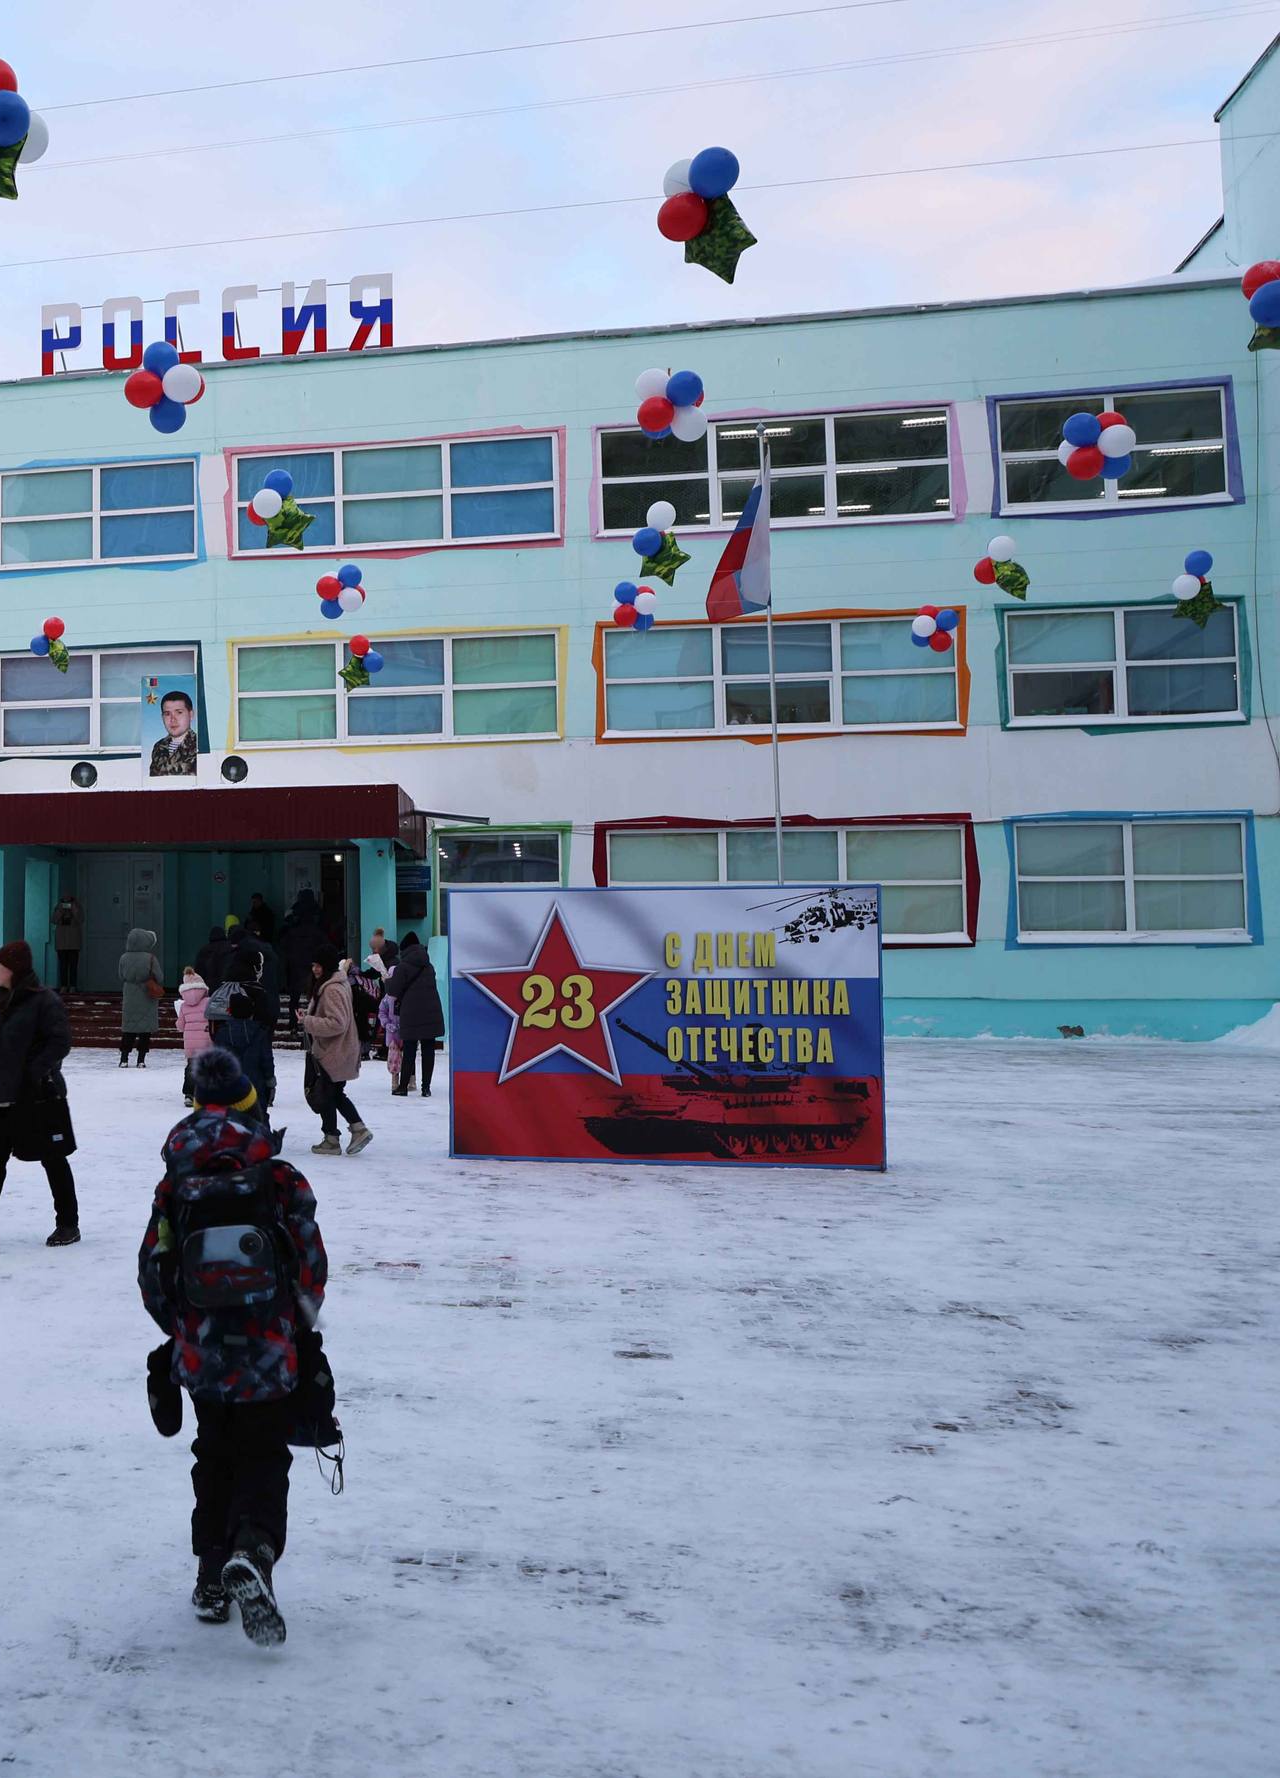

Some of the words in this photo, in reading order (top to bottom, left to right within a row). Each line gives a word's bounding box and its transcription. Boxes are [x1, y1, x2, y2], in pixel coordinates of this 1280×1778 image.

[41, 273, 393, 376] РОССИЯ
[665, 933, 682, 968] С
[694, 933, 776, 973] ДНЕМ
[522, 974, 595, 1029] 23
[666, 979, 850, 1020] ЗАЩИТНИКА
[667, 1026, 834, 1063] ОТЕЧЕСТВА
